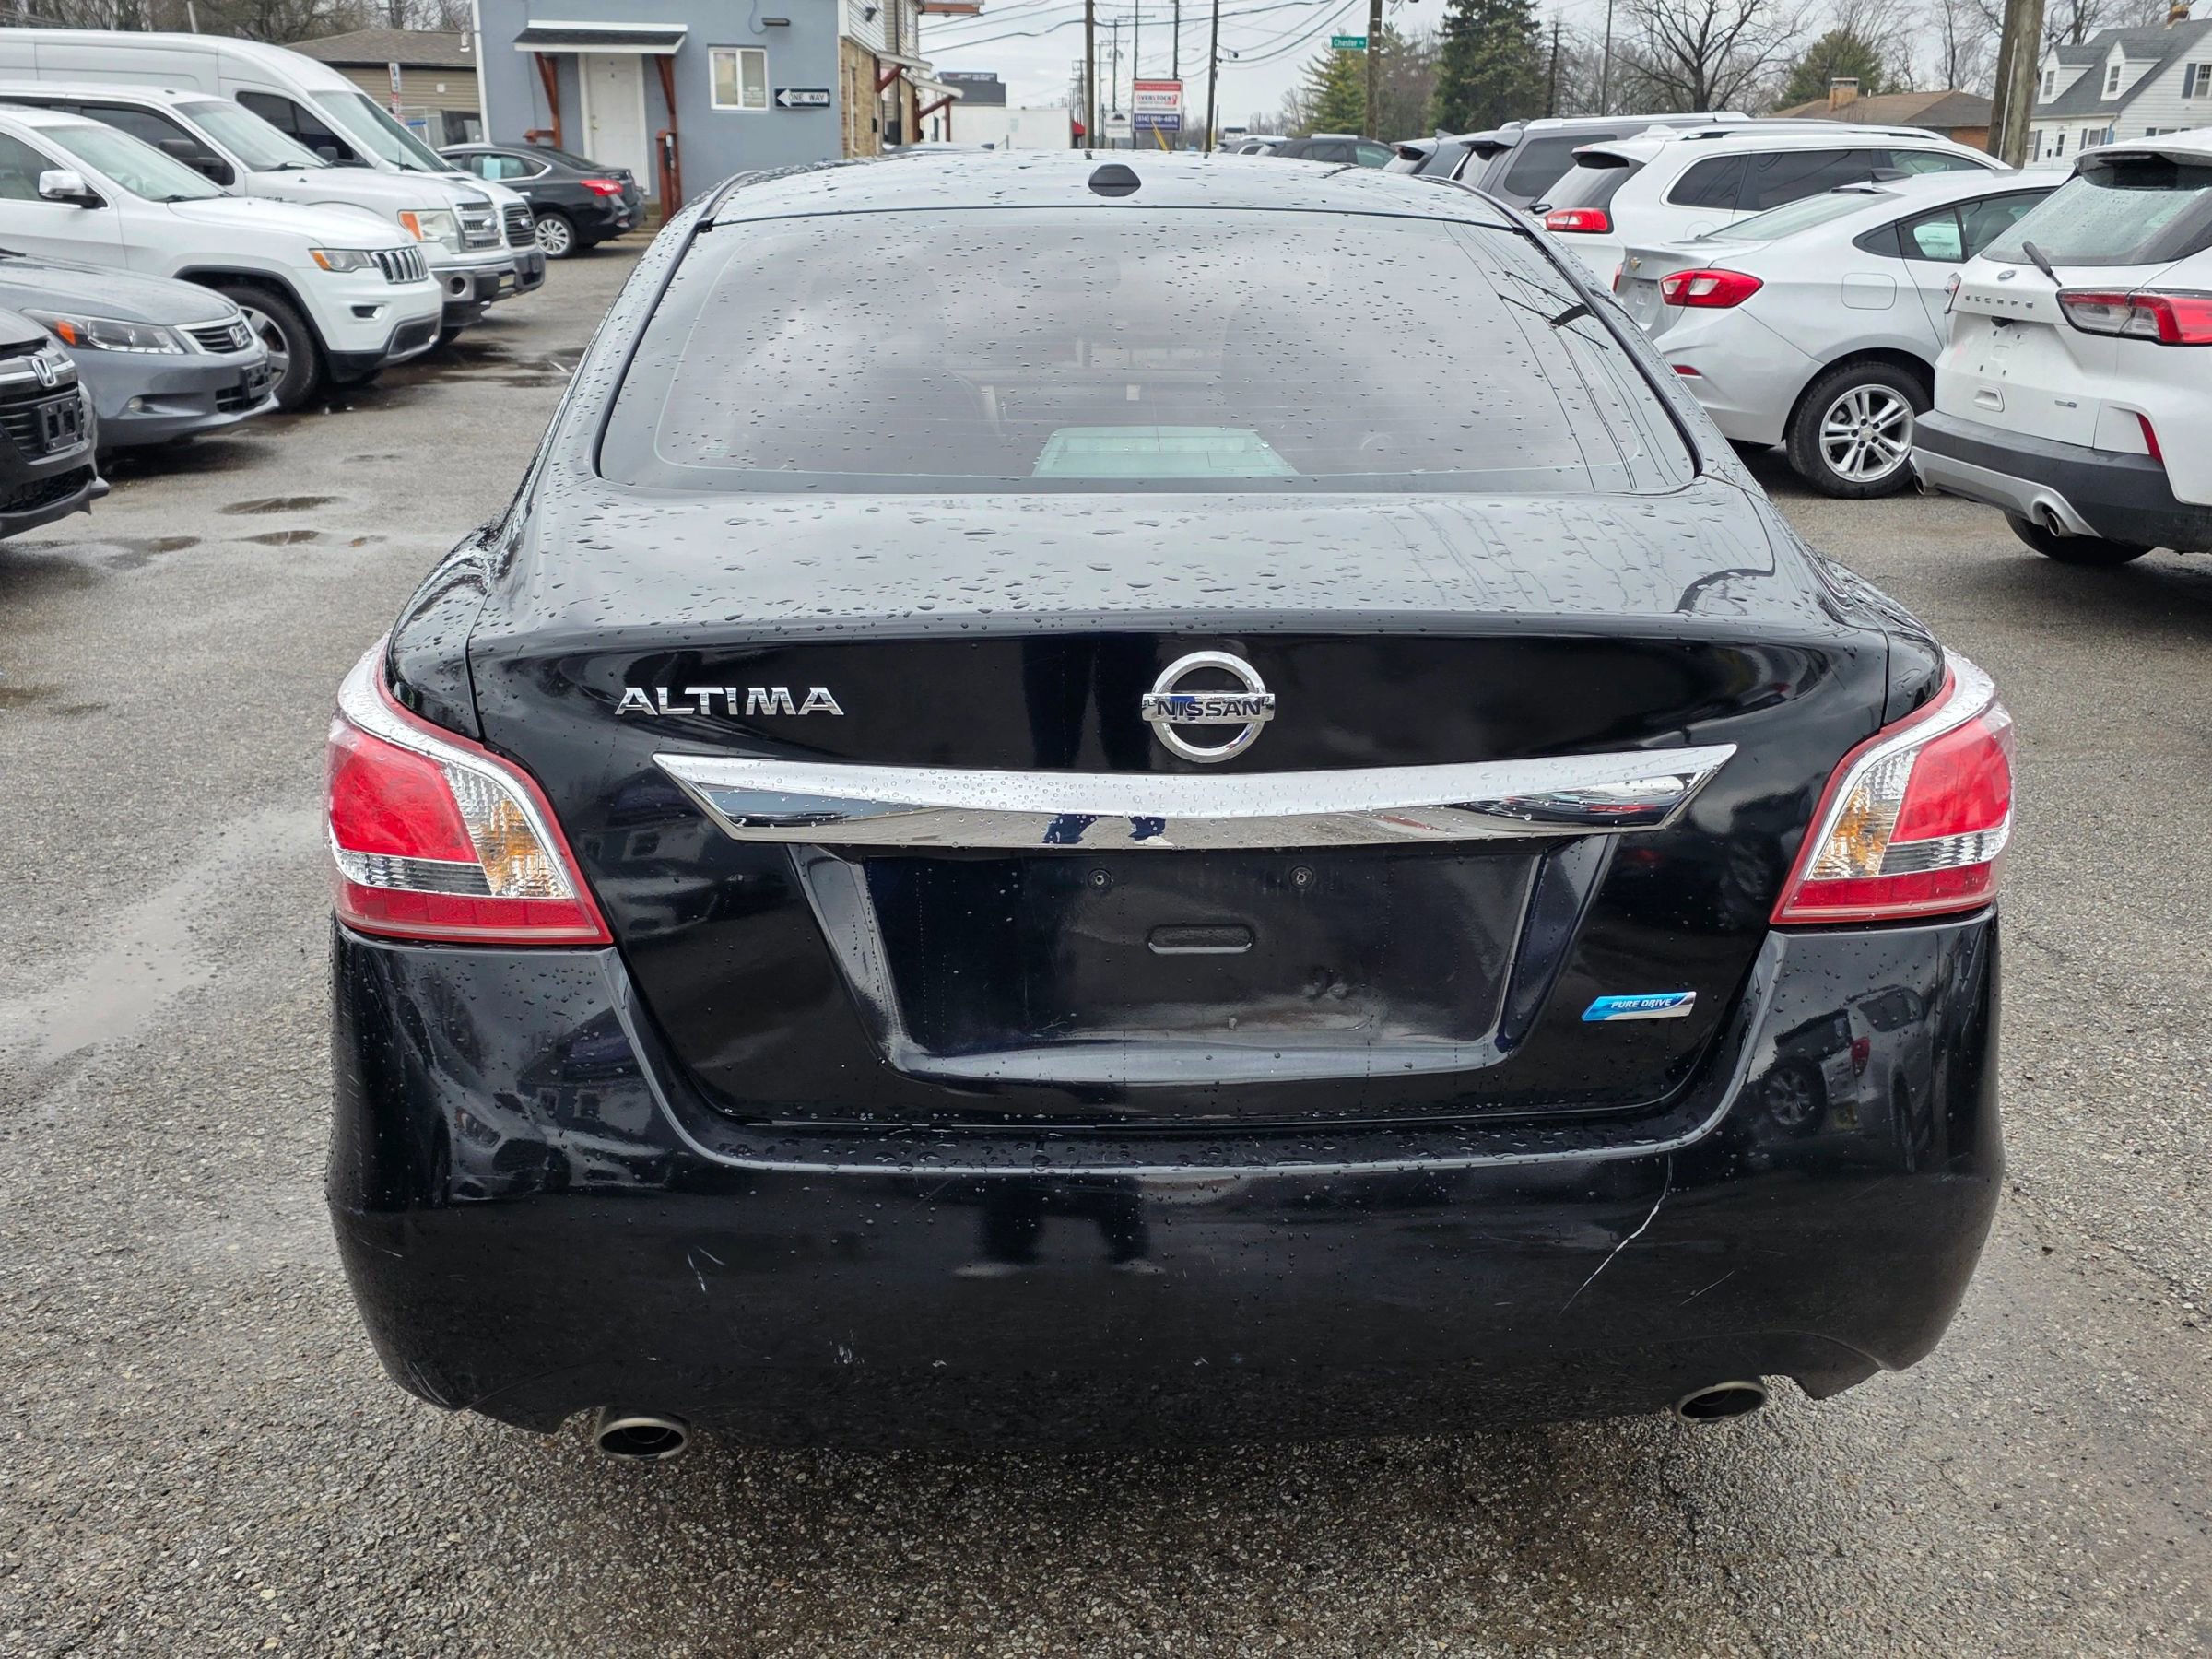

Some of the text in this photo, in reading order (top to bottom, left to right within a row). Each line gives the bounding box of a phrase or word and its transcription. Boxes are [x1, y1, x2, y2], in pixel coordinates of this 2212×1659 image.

[789, 93, 825, 101] ONE WAY
[1965, 295, 2034, 309] ESCAPE
[614, 687, 844, 715] ALTIMA
[1157, 700, 1261, 717] NISSAN
[1611, 998, 1673, 1009] PURE DRIVE
